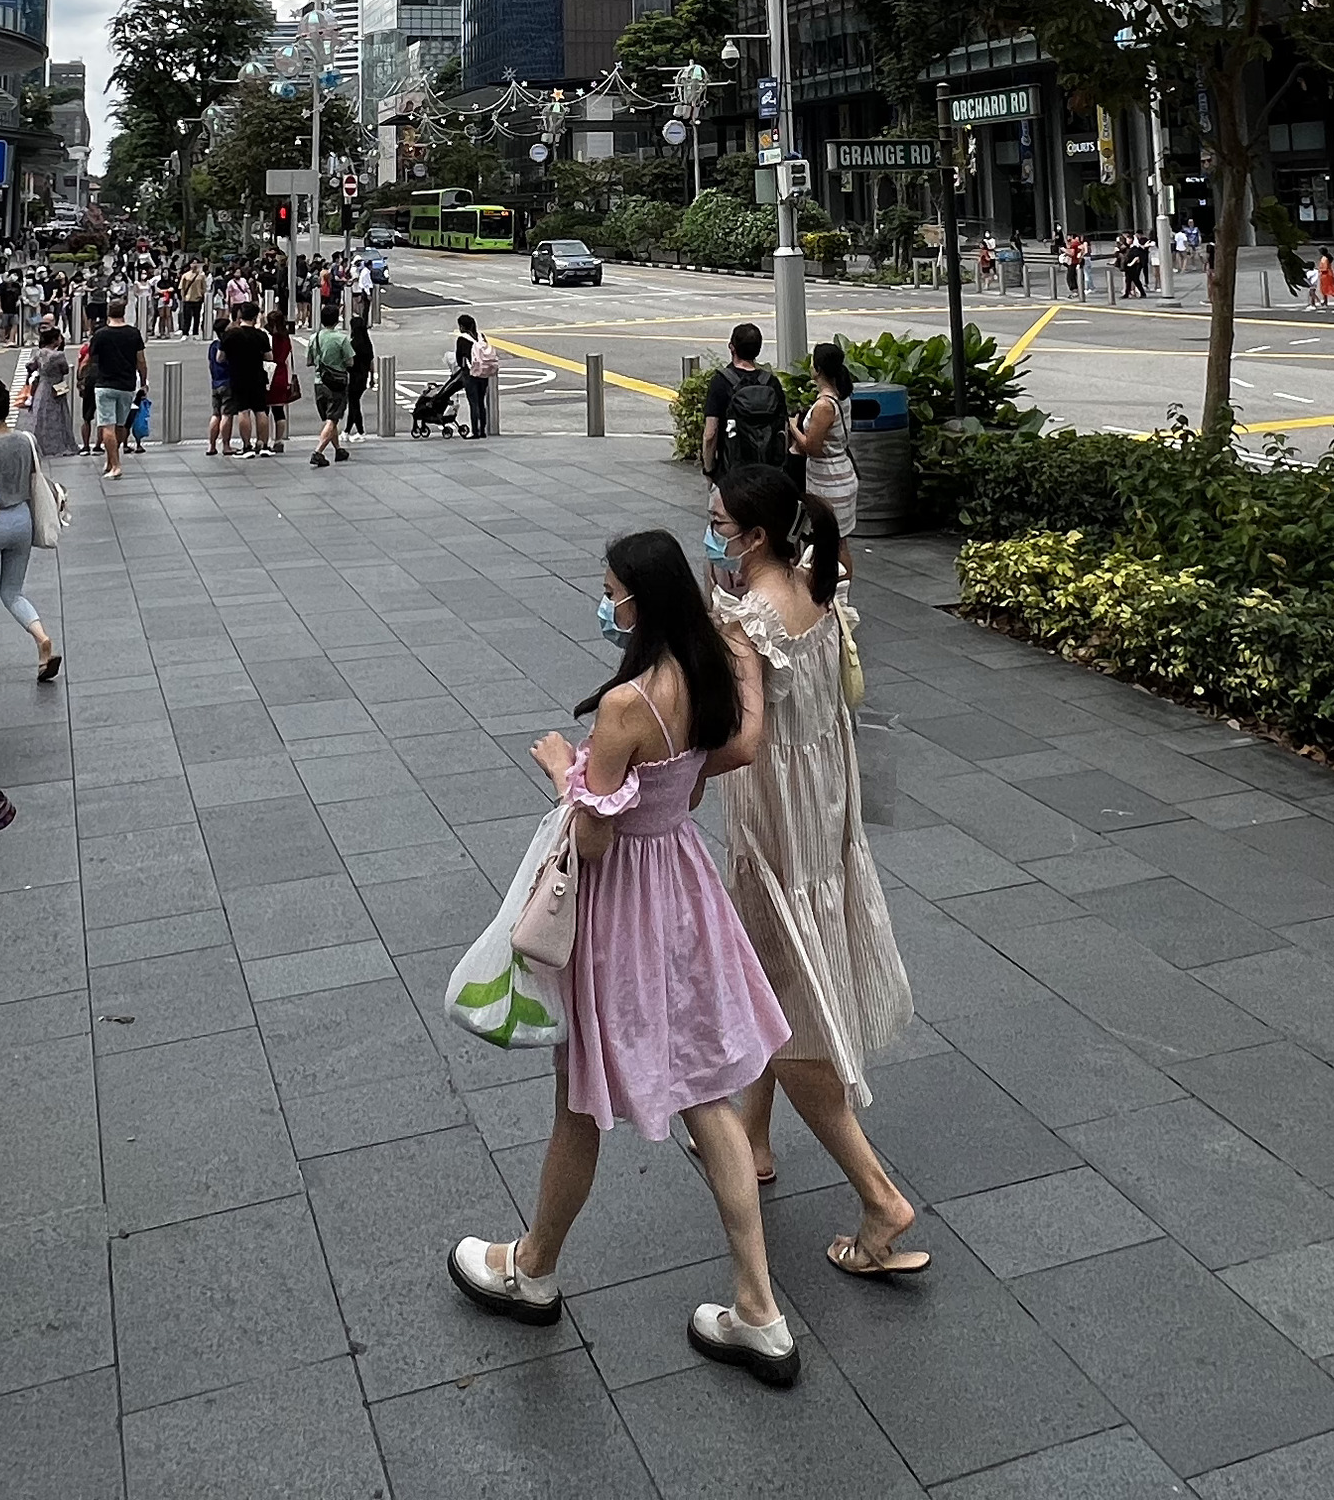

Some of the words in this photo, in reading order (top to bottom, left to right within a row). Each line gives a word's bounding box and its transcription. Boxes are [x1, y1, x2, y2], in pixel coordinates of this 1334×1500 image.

[952, 95, 1007, 122] ORCHARD
[1010, 91, 1027, 113] RD
[840, 144, 905, 166] GRANGE
[910, 144, 931, 165] RD
